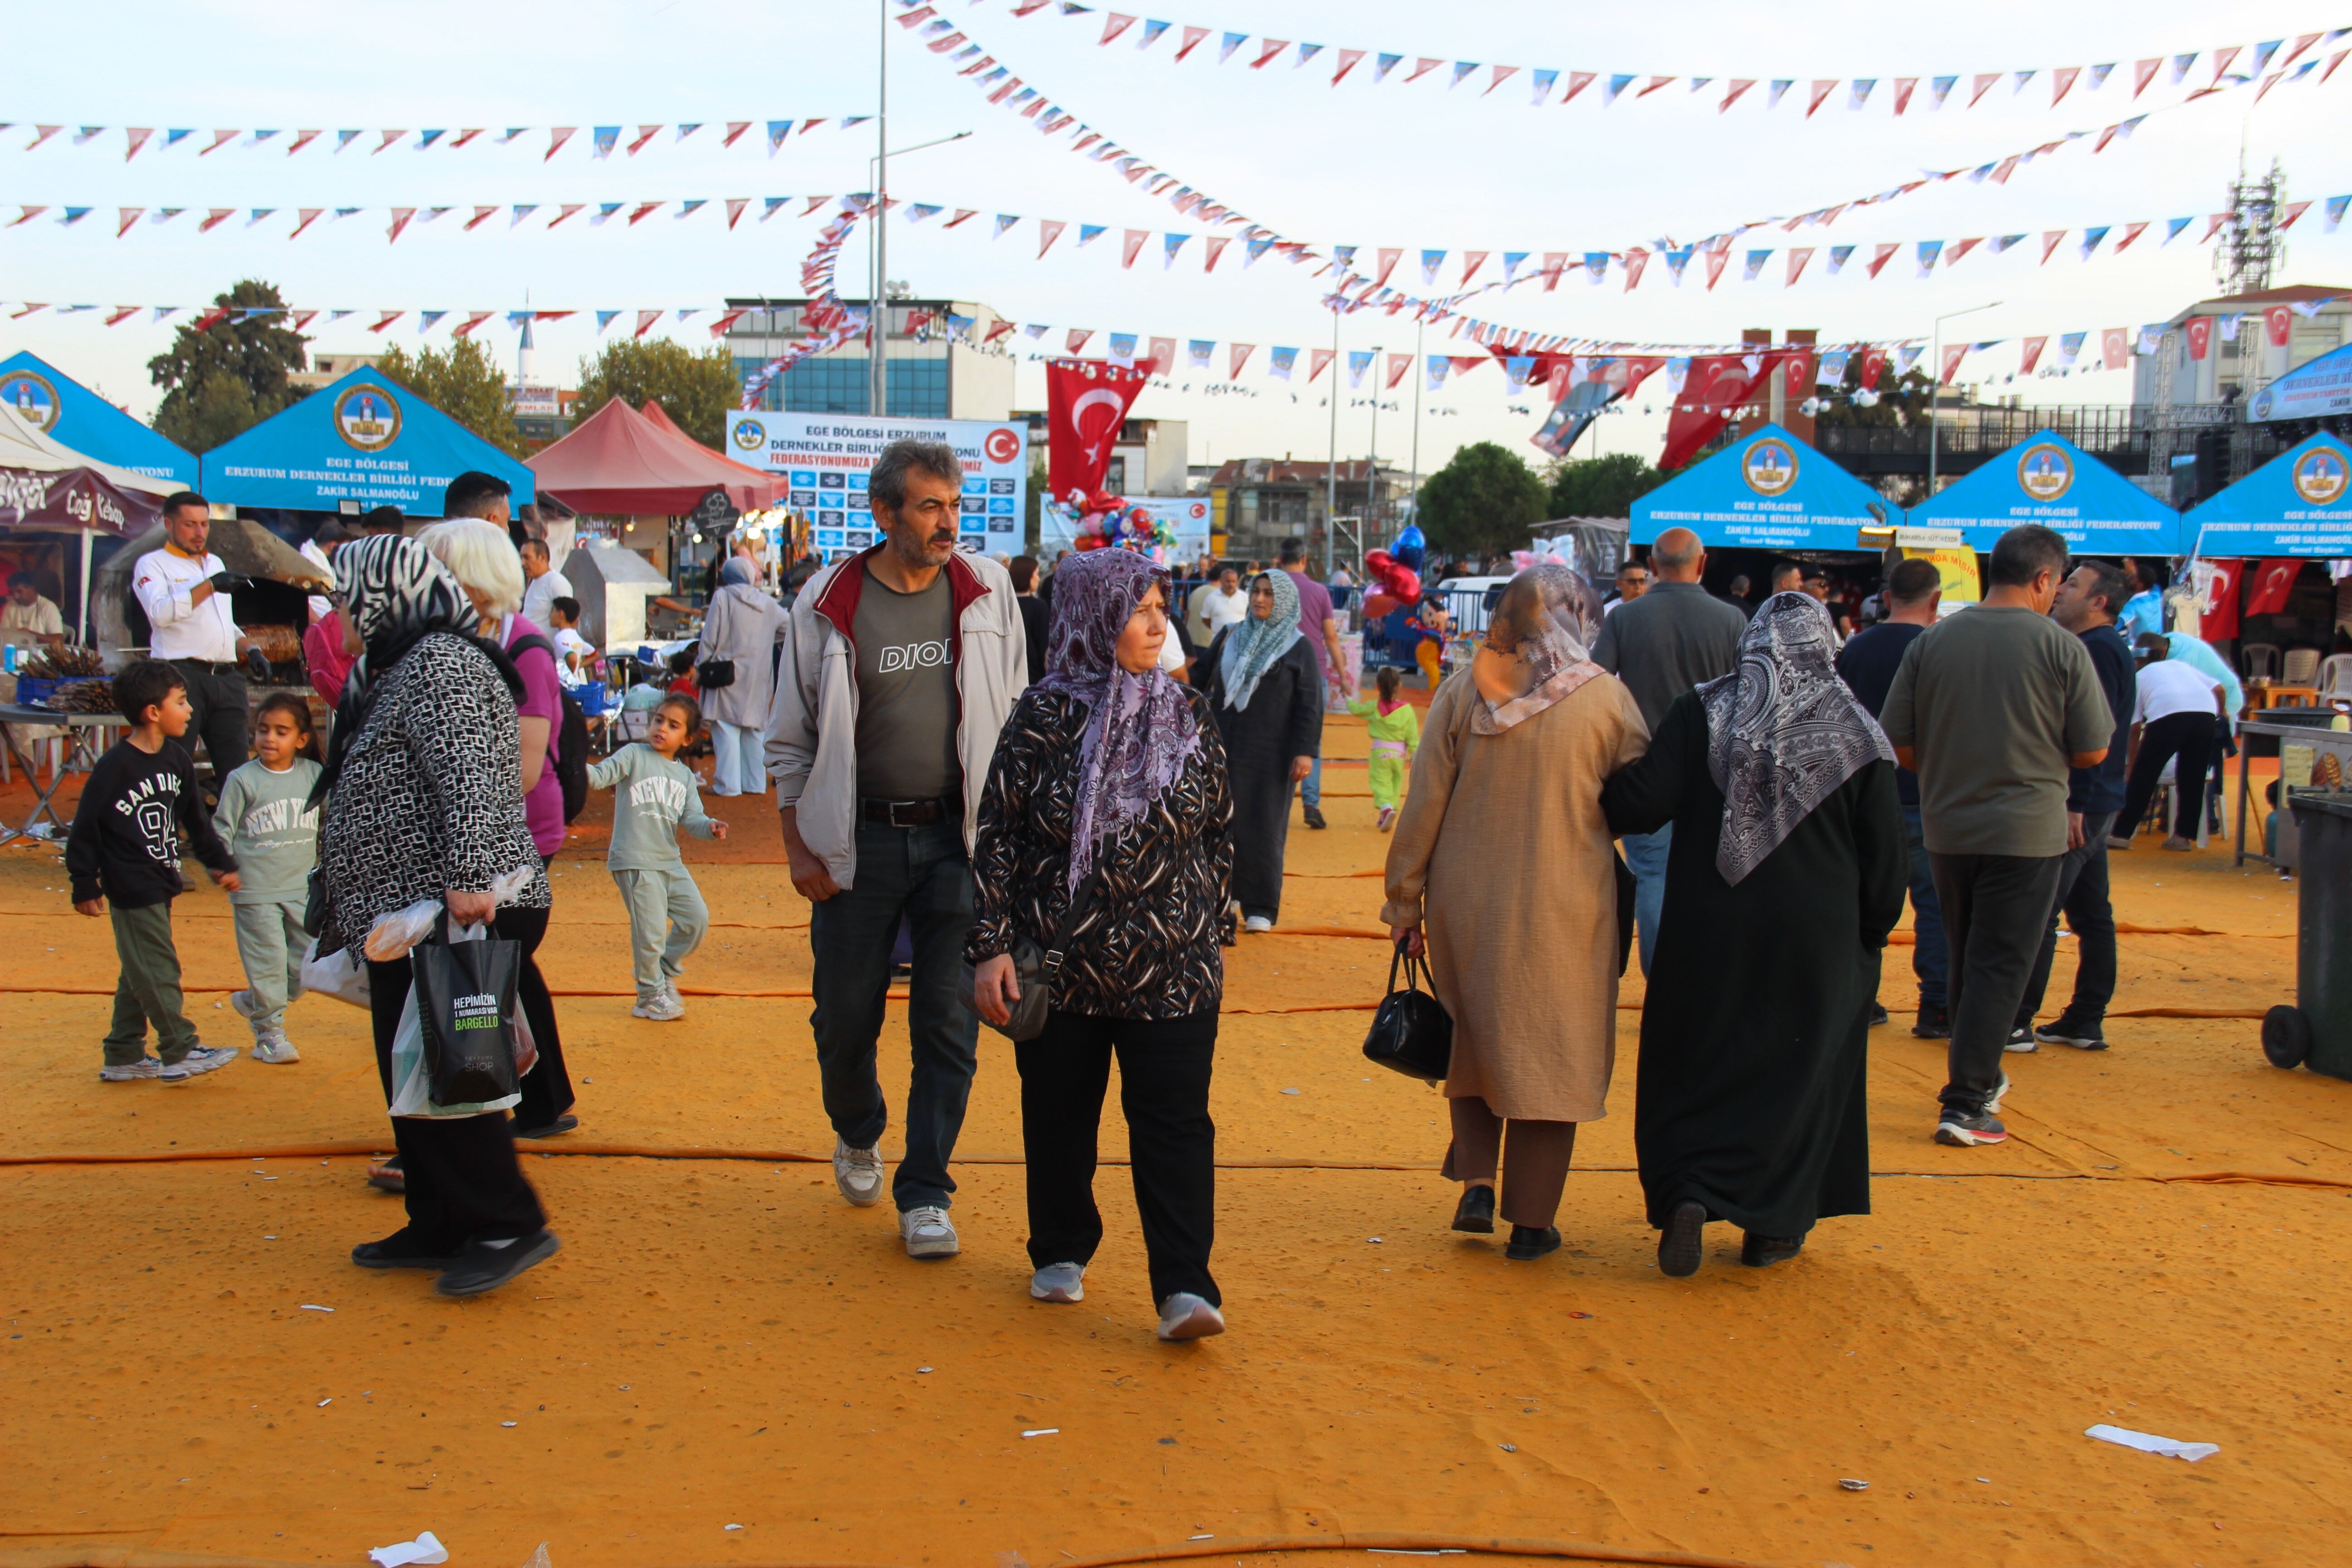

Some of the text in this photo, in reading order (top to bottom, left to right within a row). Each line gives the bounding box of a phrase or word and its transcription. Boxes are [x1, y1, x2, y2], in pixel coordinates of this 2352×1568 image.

[806, 426, 830, 436] EGE
[833, 425, 883, 439] BÖLGESİ
[771, 440, 843, 453] DERNEKLER
[326, 457, 409, 471] EGE BÖLGESİ
[770, 453, 870, 468] FEDERASYONUMUZA
[225, 466, 286, 479] ERZURUM
[289, 469, 366, 483] DERNEKLER
[369, 472, 416, 485] BİRLİĞİ
[316, 485, 419, 500] ZAKİR SALMANOĞLU
[1734, 500, 1803, 512] EGE BÖLGESİ
[2009, 505, 2078, 517] EGE BÖLGESİ
[1650, 511, 1882, 527] ERZURUM DERNEKLER BİRLİĞİ FEDERASYON
[2283, 510, 2305, 520] EGE
[1725, 524, 1811, 537] ZAKİR SALMANOĞLU
[1927, 517, 1978, 527] ERZURUM
[2044, 519, 2084, 529] BİRLİĞİ
[2086, 520, 2162, 530] FEDERASYONU
[2201, 522, 2251, 532] ERZURUM
[2253, 523, 2316, 532] DERNEKLER
[2274, 534, 2301, 544] ZAKİR
[116, 778, 155, 816] SAN
[629, 776, 668, 808] NEW
[245, 798, 288, 838] NEW
[454, 993, 496, 1009] HEPİMİZİN
[459, 1007, 486, 1017] NUMARASI
[455, 1015, 498, 1031] BARGELLO
[466, 1062, 494, 1072] SHOP
